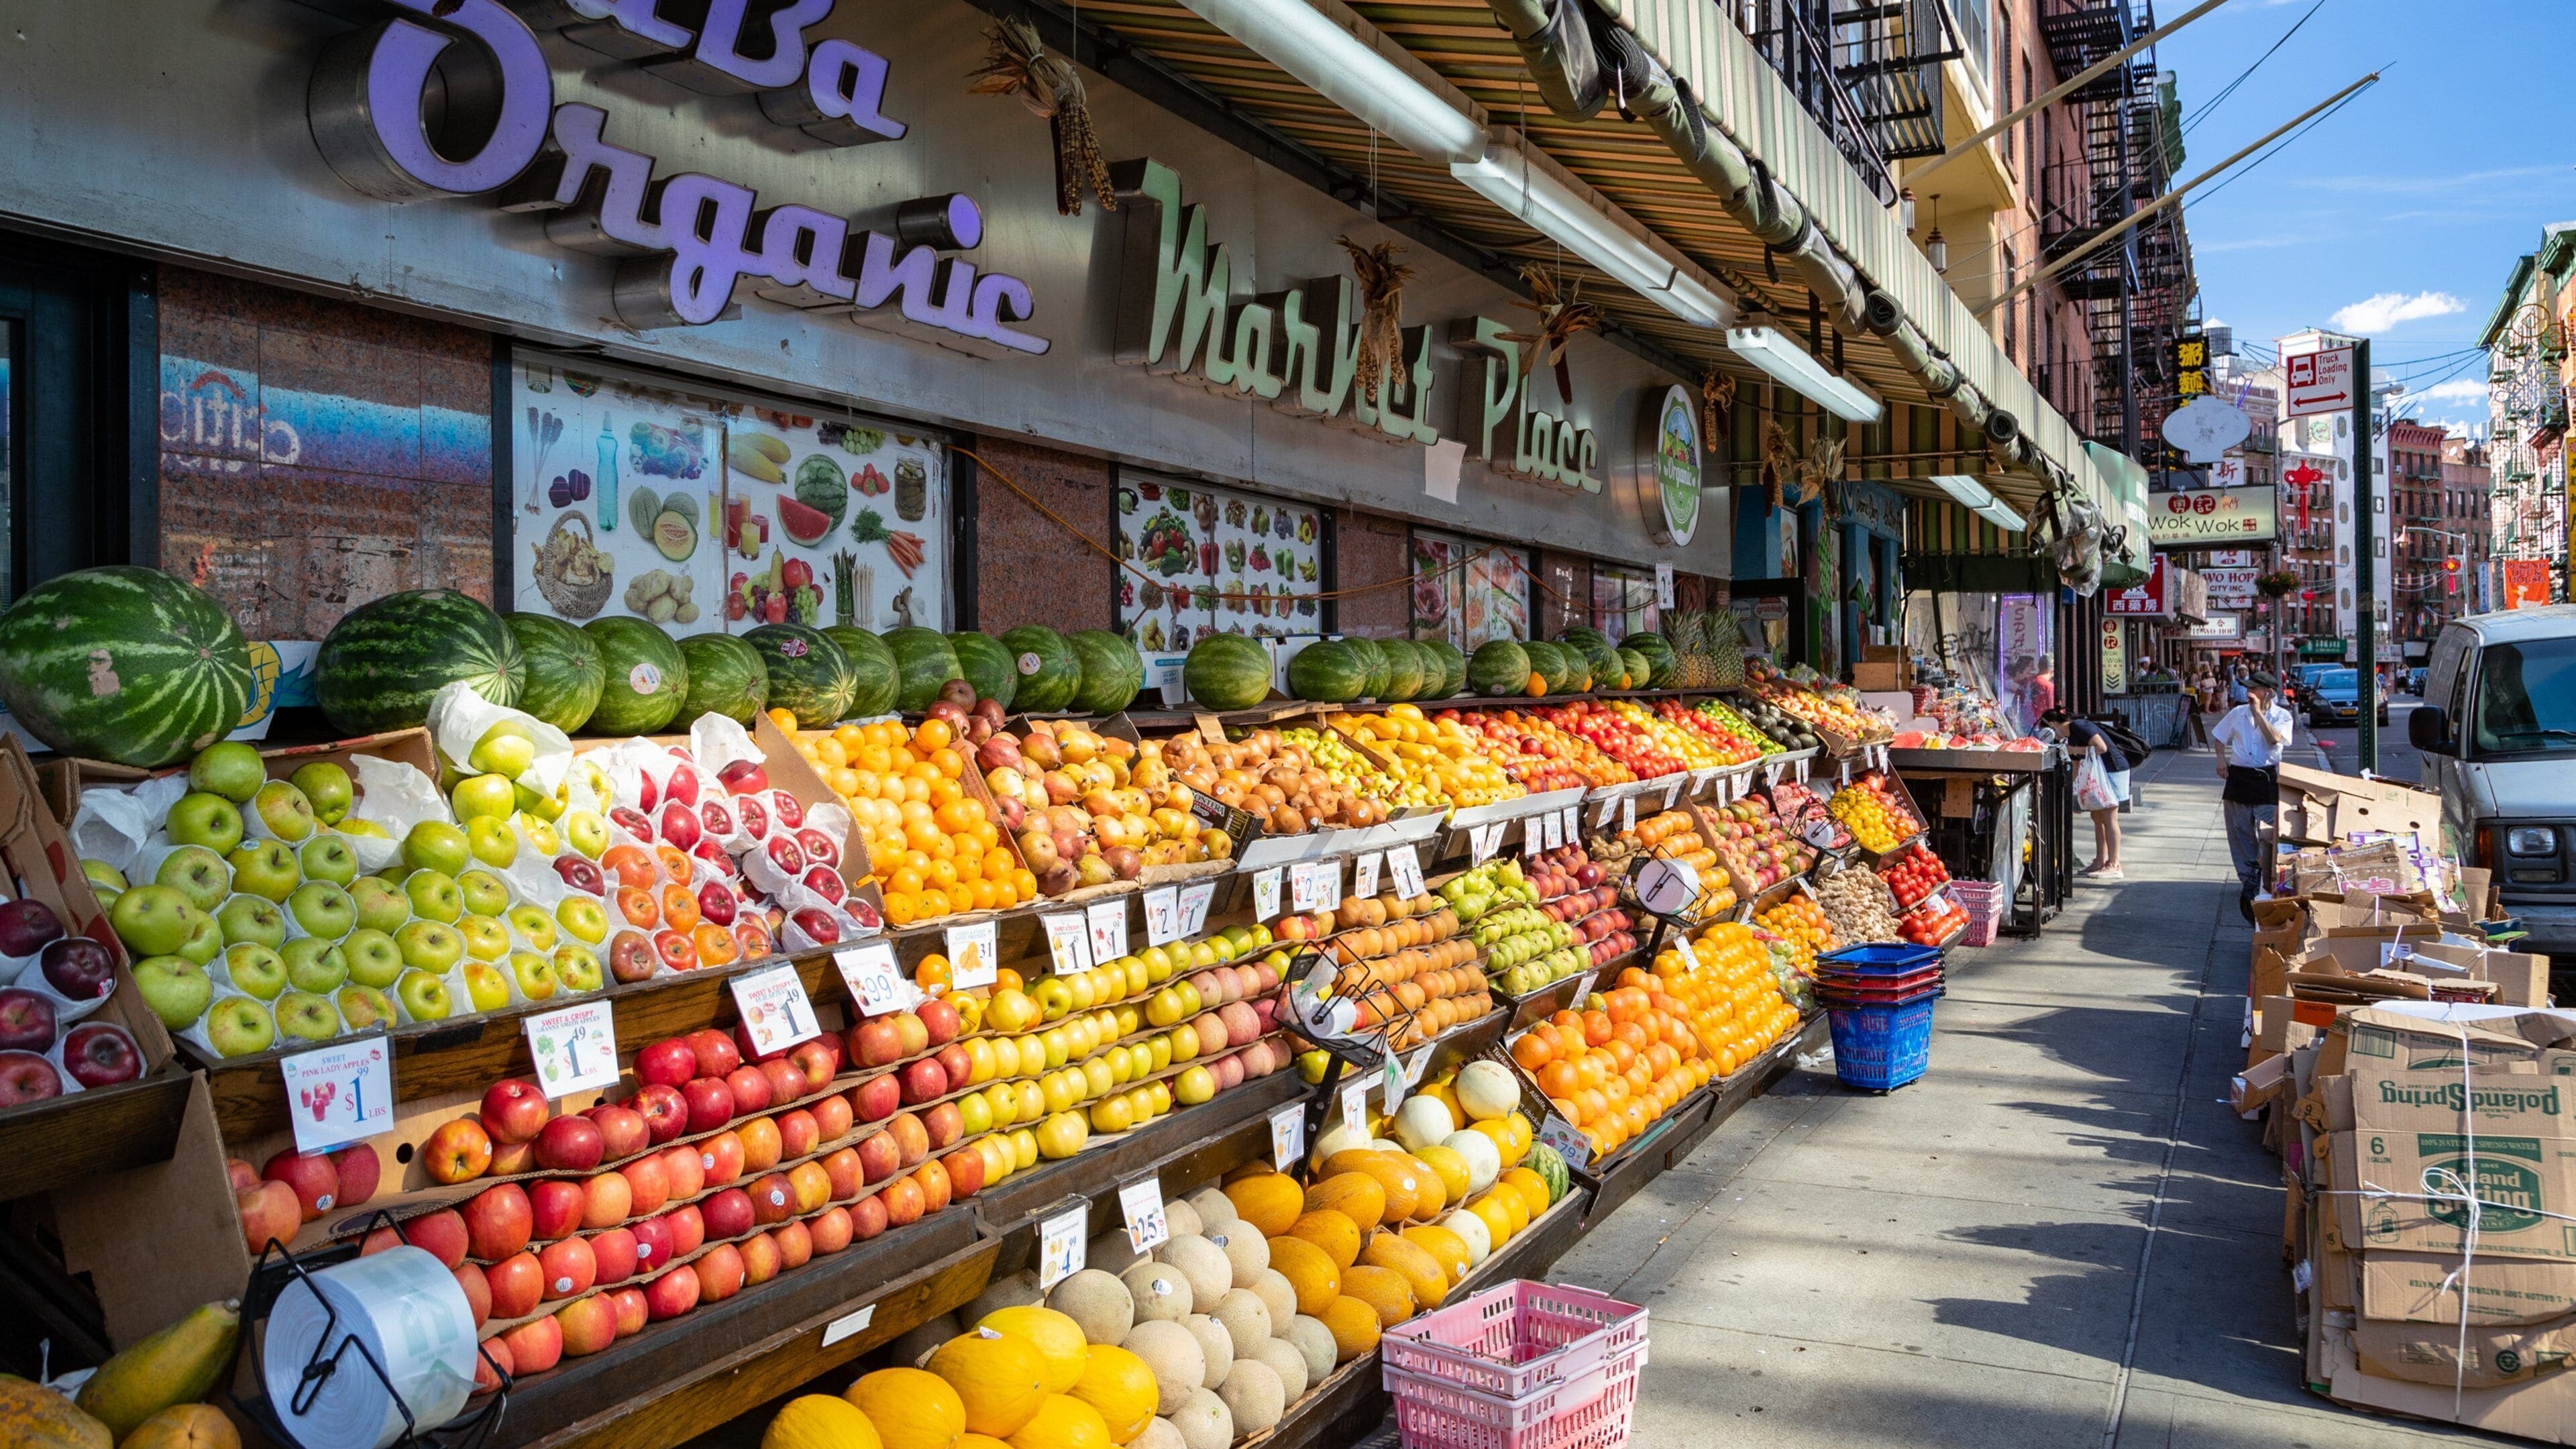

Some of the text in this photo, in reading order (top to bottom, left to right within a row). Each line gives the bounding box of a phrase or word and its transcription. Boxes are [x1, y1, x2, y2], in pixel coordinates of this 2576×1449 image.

[368, 0, 1051, 355] Organic
[2318, 353, 2339, 365] Truck
[2178, 342, 2203, 407] 粥麵
[2318, 363, 2347, 375] Loading
[2319, 375, 2336, 385] Only
[1474, 316, 1602, 494] Place
[1668, 458, 1692, 488] Organic
[2148, 515, 2190, 529] Wok
[2195, 519, 2239, 533] Wok
[2229, 573, 2254, 582] HOP
[2112, 600, 2157, 611] 西藥房
[749, 989, 765, 1000] SWEET
[772, 981, 790, 991] CRISPY
[865, 975, 892, 1002] 99
[537, 1015, 600, 1033] GRANNY SMITH APPLES
[541, 1016, 562, 1026] SWEET
[572, 1010, 593, 1020] CRISPY
[302, 1059, 370, 1077] PINK LADY APPLES
[321, 1054, 346, 1065] SWEET
[357, 1066, 369, 1077] 99
[1493, 1046, 1513, 1070] Turkey
[1529, 1089, 1546, 1111] Alfalfa,
[2379, 1081, 2561, 1116] Poland Spring
[369, 1107, 386, 1118] LBS
[1559, 1142, 1576, 1158] 79
[2370, 1136, 2385, 1156] 6
[2478, 1141, 2508, 1149] SPRING
[2508, 1142, 2538, 1151] WATER
[2441, 1167, 2521, 1187] Poland
[2409, 1279, 2434, 1289] WATER
[2525, 1293, 2555, 1303] GALLON
